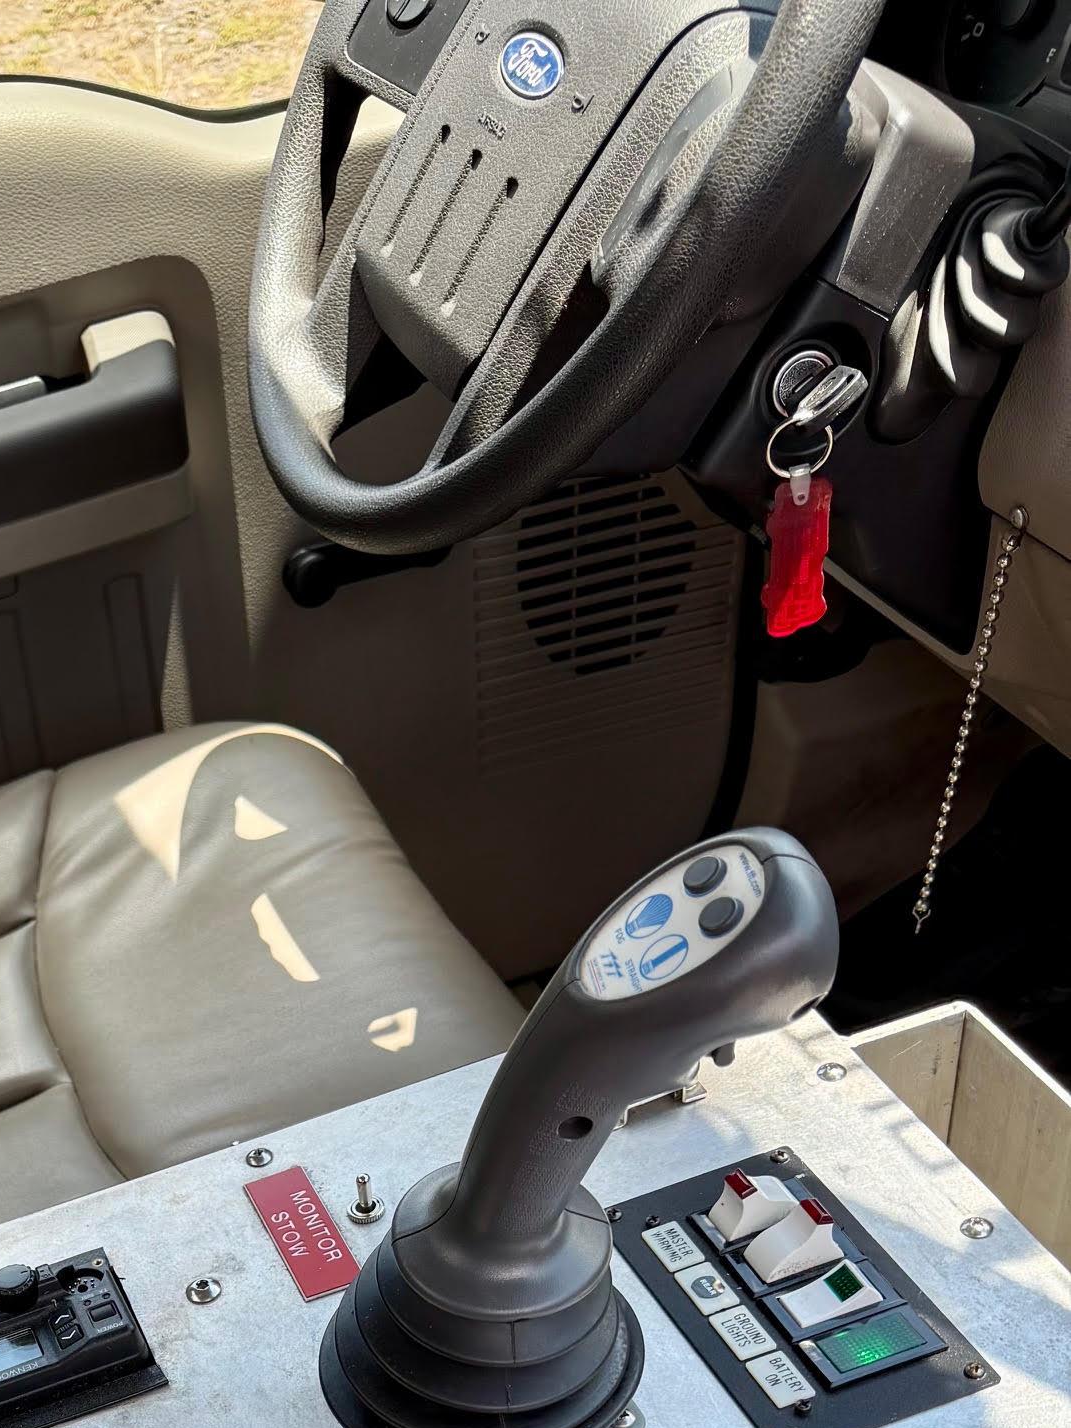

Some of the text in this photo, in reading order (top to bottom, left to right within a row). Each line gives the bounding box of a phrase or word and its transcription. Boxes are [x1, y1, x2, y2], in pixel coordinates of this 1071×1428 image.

[508, 39, 552, 87] Ford
[271, 1211, 310, 1257] STOW
[289, 1190, 343, 1262] MONITOR
[664, 1227, 694, 1257] MASTER
[651, 1231, 682, 1263] WARNING
[96, 1321, 124, 1334] POWER
[721, 1319, 752, 1348] LIGHTS
[734, 1312, 767, 1345] GROUND
[765, 1373, 783, 1387] ON
[769, 1357, 806, 1392] BATTERY
